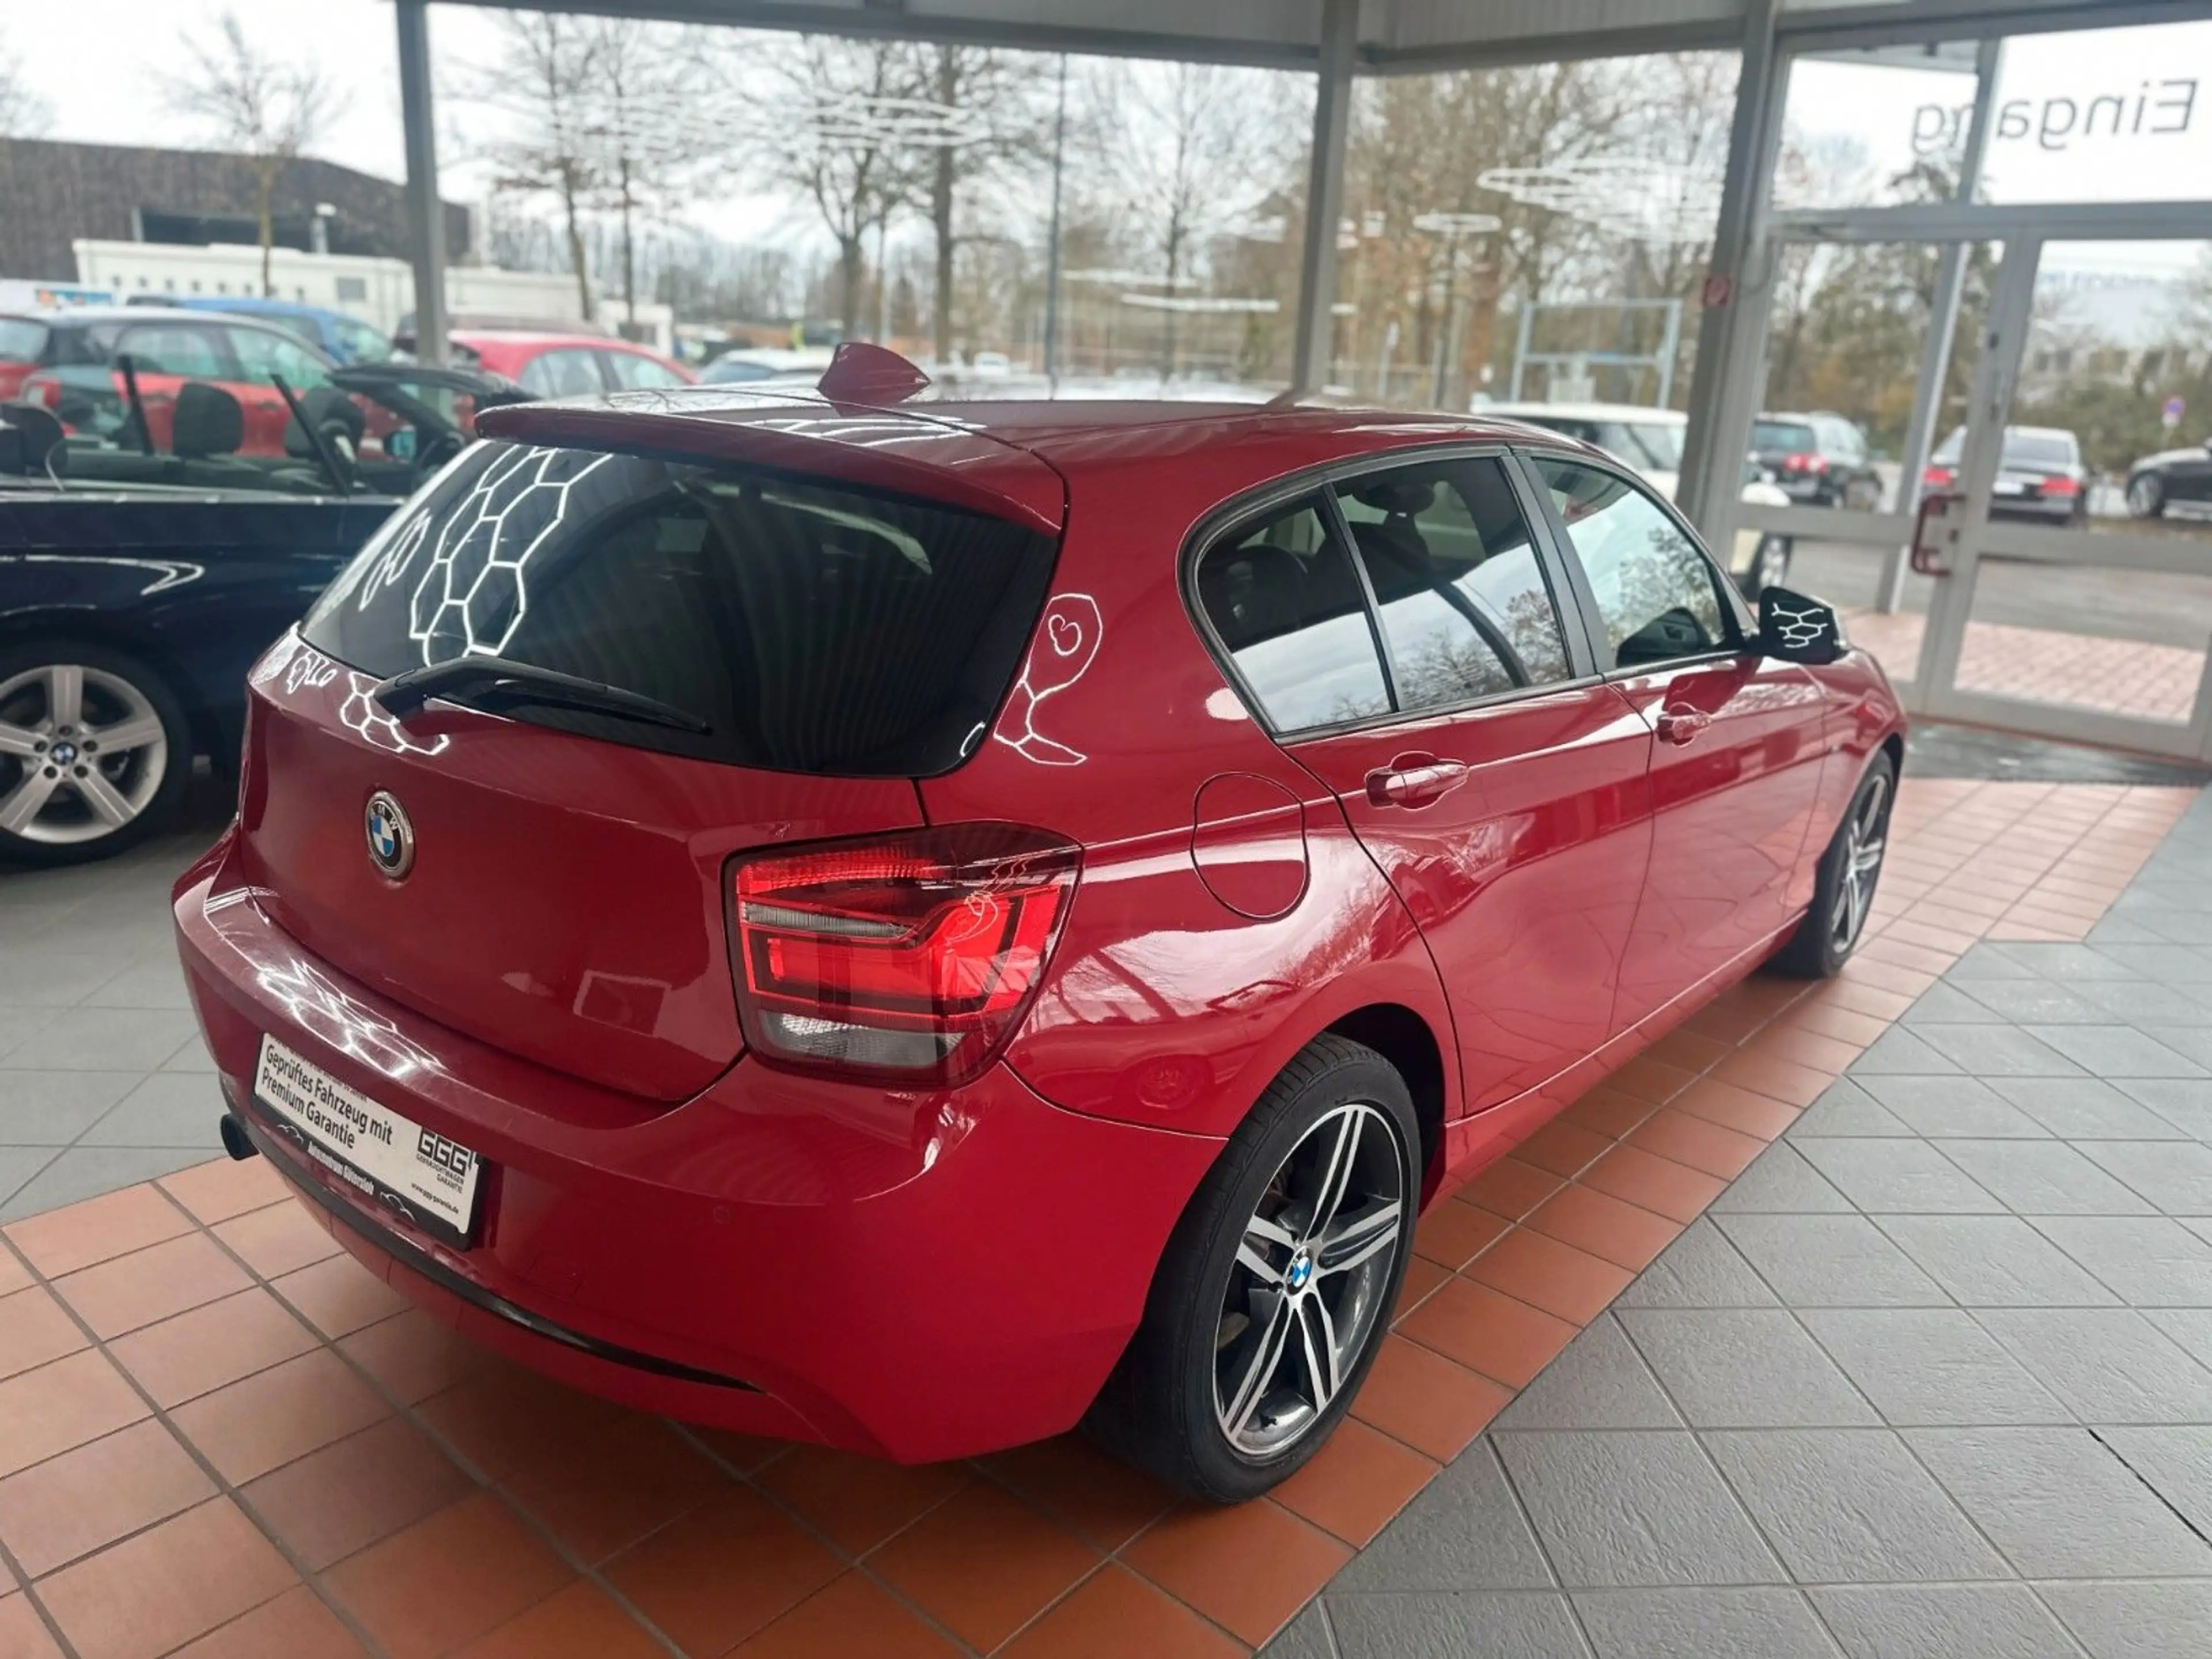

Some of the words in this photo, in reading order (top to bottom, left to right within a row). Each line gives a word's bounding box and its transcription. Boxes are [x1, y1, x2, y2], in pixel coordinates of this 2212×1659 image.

[263, 1067, 305, 1114] Premium
[306, 1101, 355, 1149] Garantie
[267, 1044, 313, 1093] Geprüftes
[315, 1078, 368, 1134] Fahrzeug
[370, 1119, 393, 1145] mit
[418, 1129, 470, 1177] GGG
